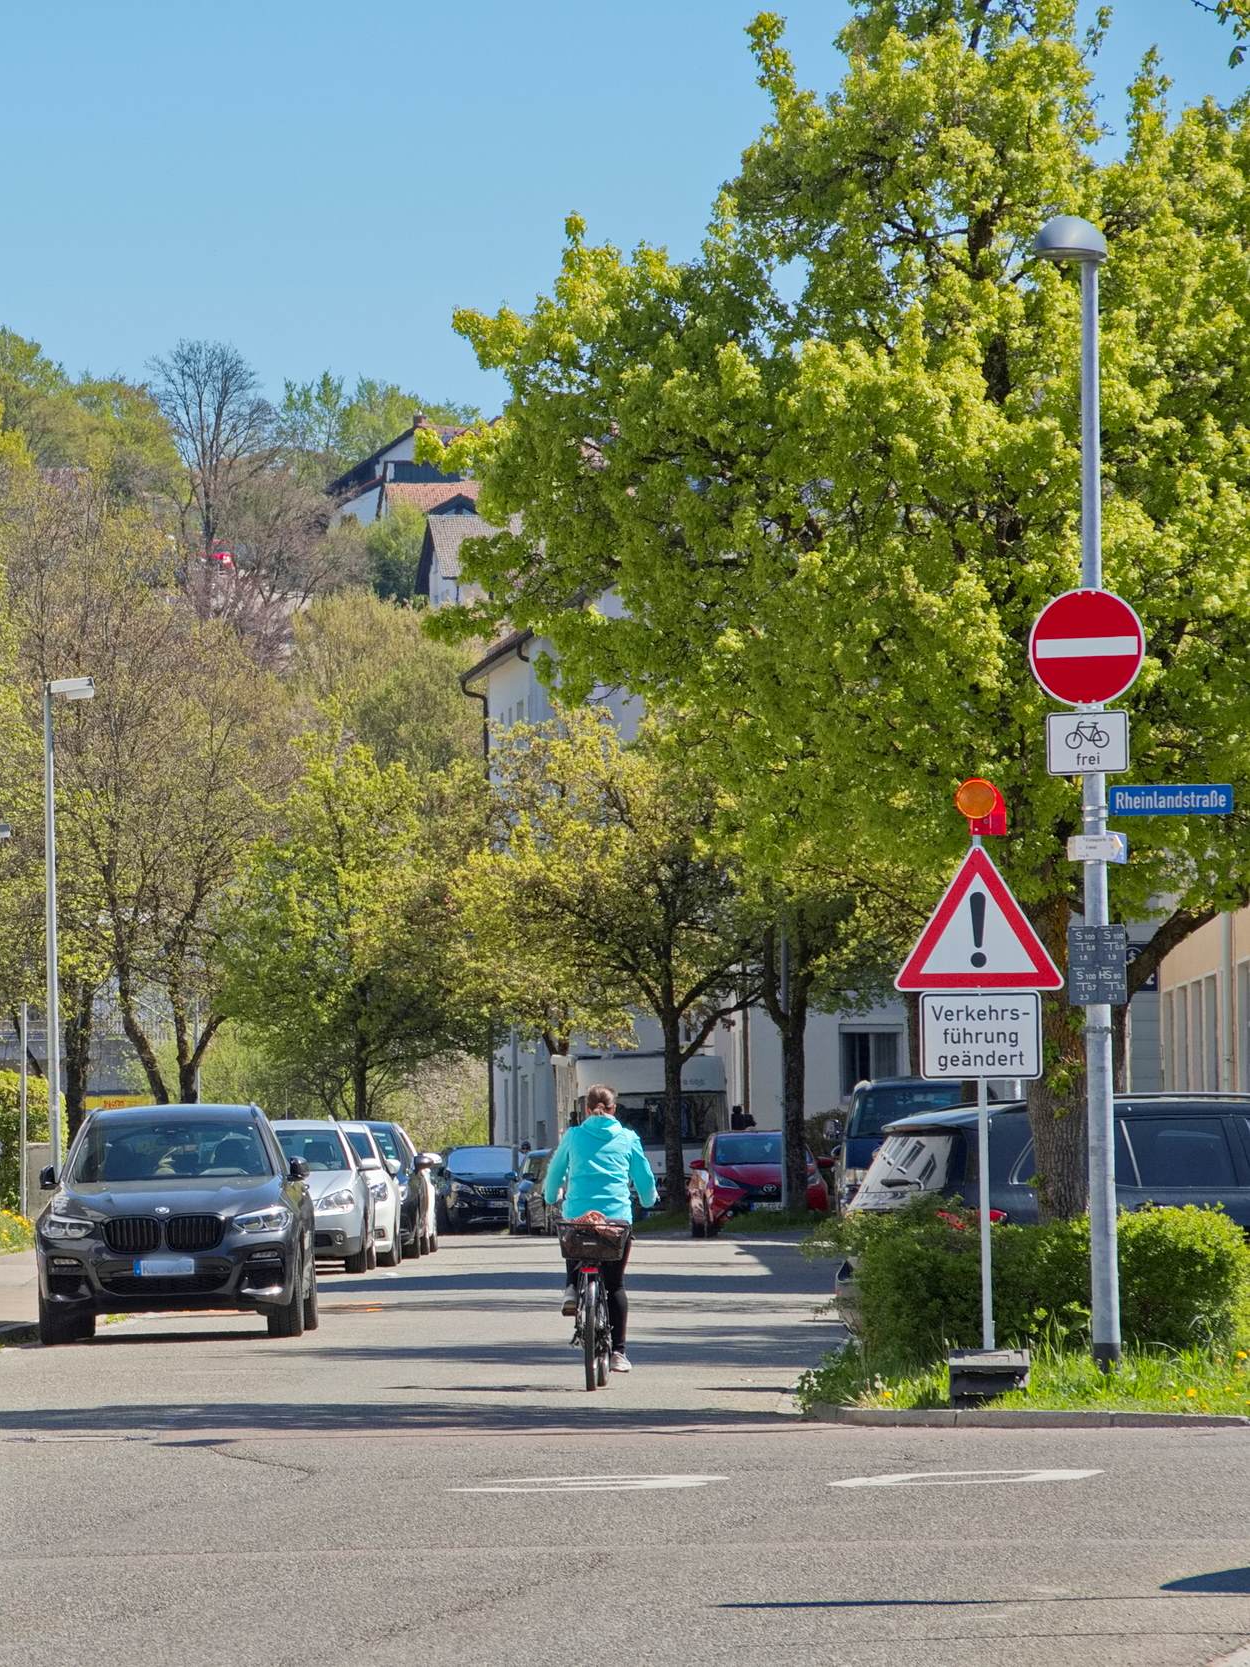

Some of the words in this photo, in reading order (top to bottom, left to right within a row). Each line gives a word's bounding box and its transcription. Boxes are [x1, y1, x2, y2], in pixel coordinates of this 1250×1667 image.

[1076, 752, 1100, 766] frei
[1115, 790, 1227, 810] Rheinlandstraße
[931, 1004, 1030, 1021] Verkehrs-
[943, 1027, 1019, 1048] führung
[938, 1050, 1025, 1072] geändert
